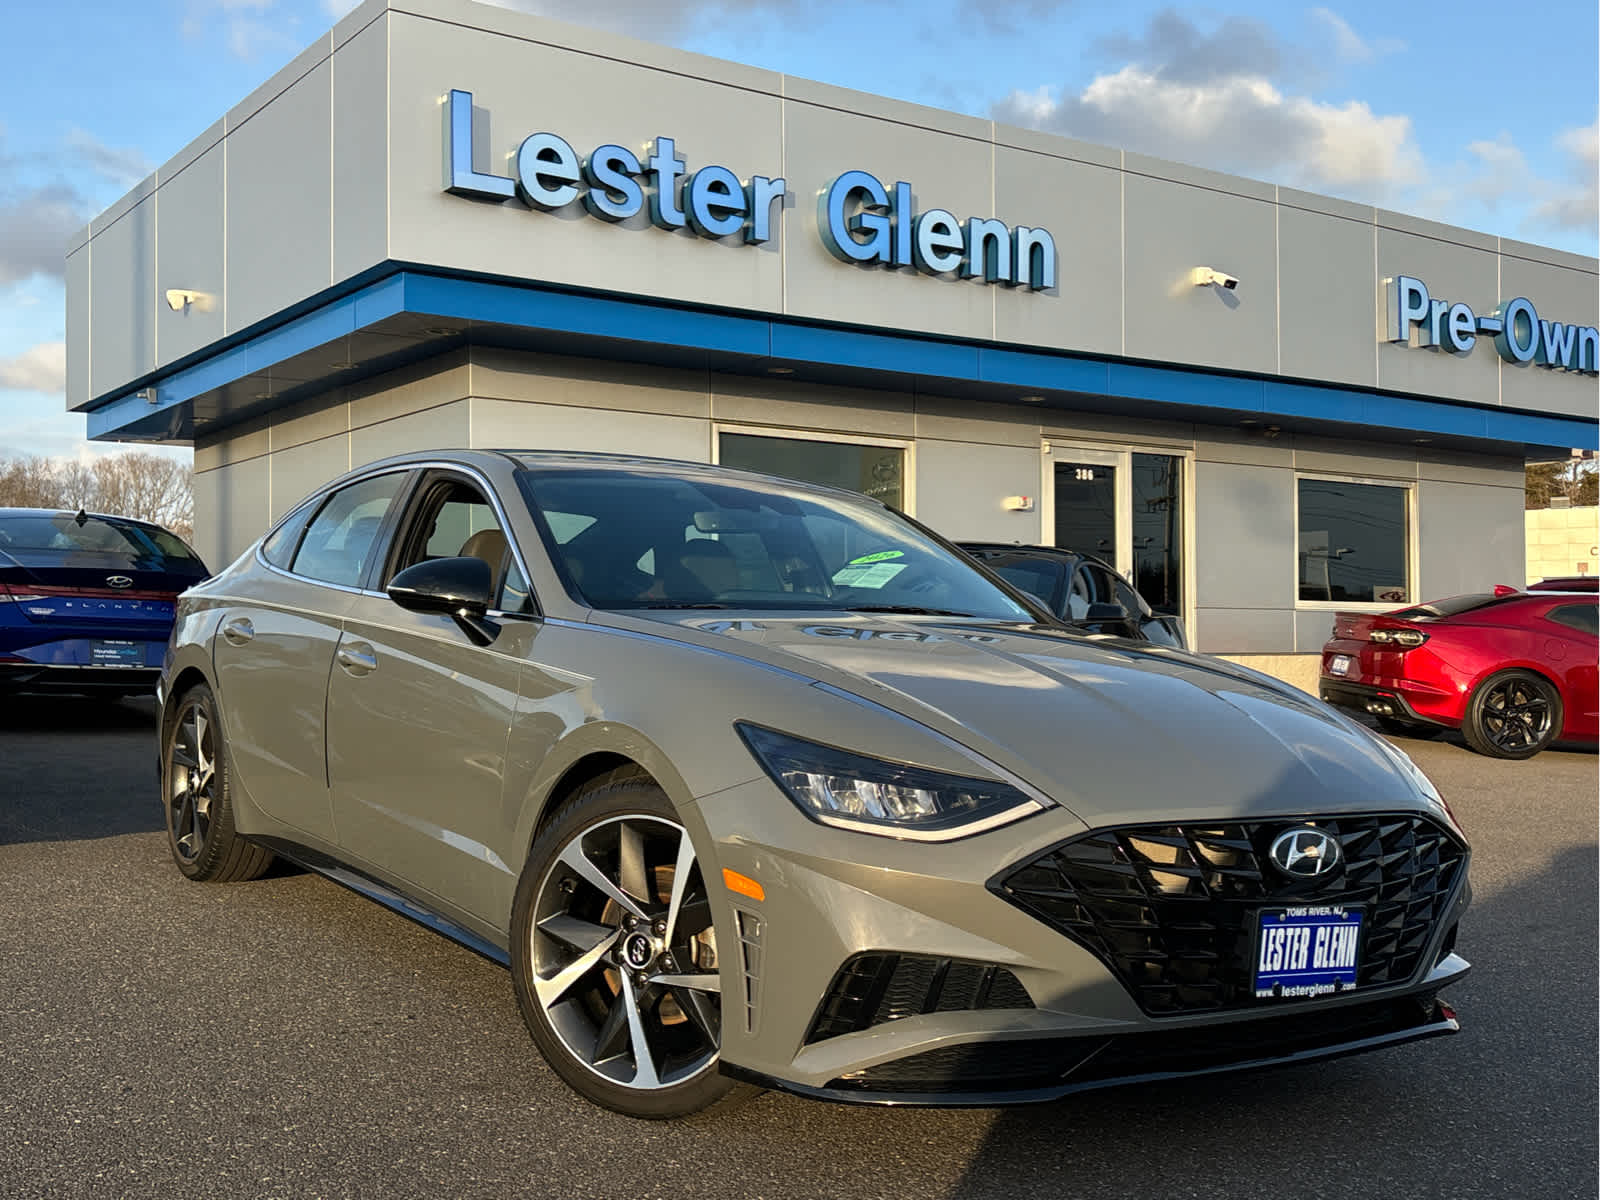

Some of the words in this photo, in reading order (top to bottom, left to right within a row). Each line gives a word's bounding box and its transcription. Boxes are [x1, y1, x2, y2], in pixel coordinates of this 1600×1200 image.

[444, 89, 787, 244] Lester
[820, 169, 1057, 290] Glenn
[1392, 274, 1599, 373] Pre-Own
[1286, 907, 1307, 917] TOMS
[1333, 905, 1344, 915] NJ
[1259, 927, 1311, 972] LESTER
[1313, 926, 1359, 968] GLENN
[1281, 983, 1336, 998] lesterglenn
